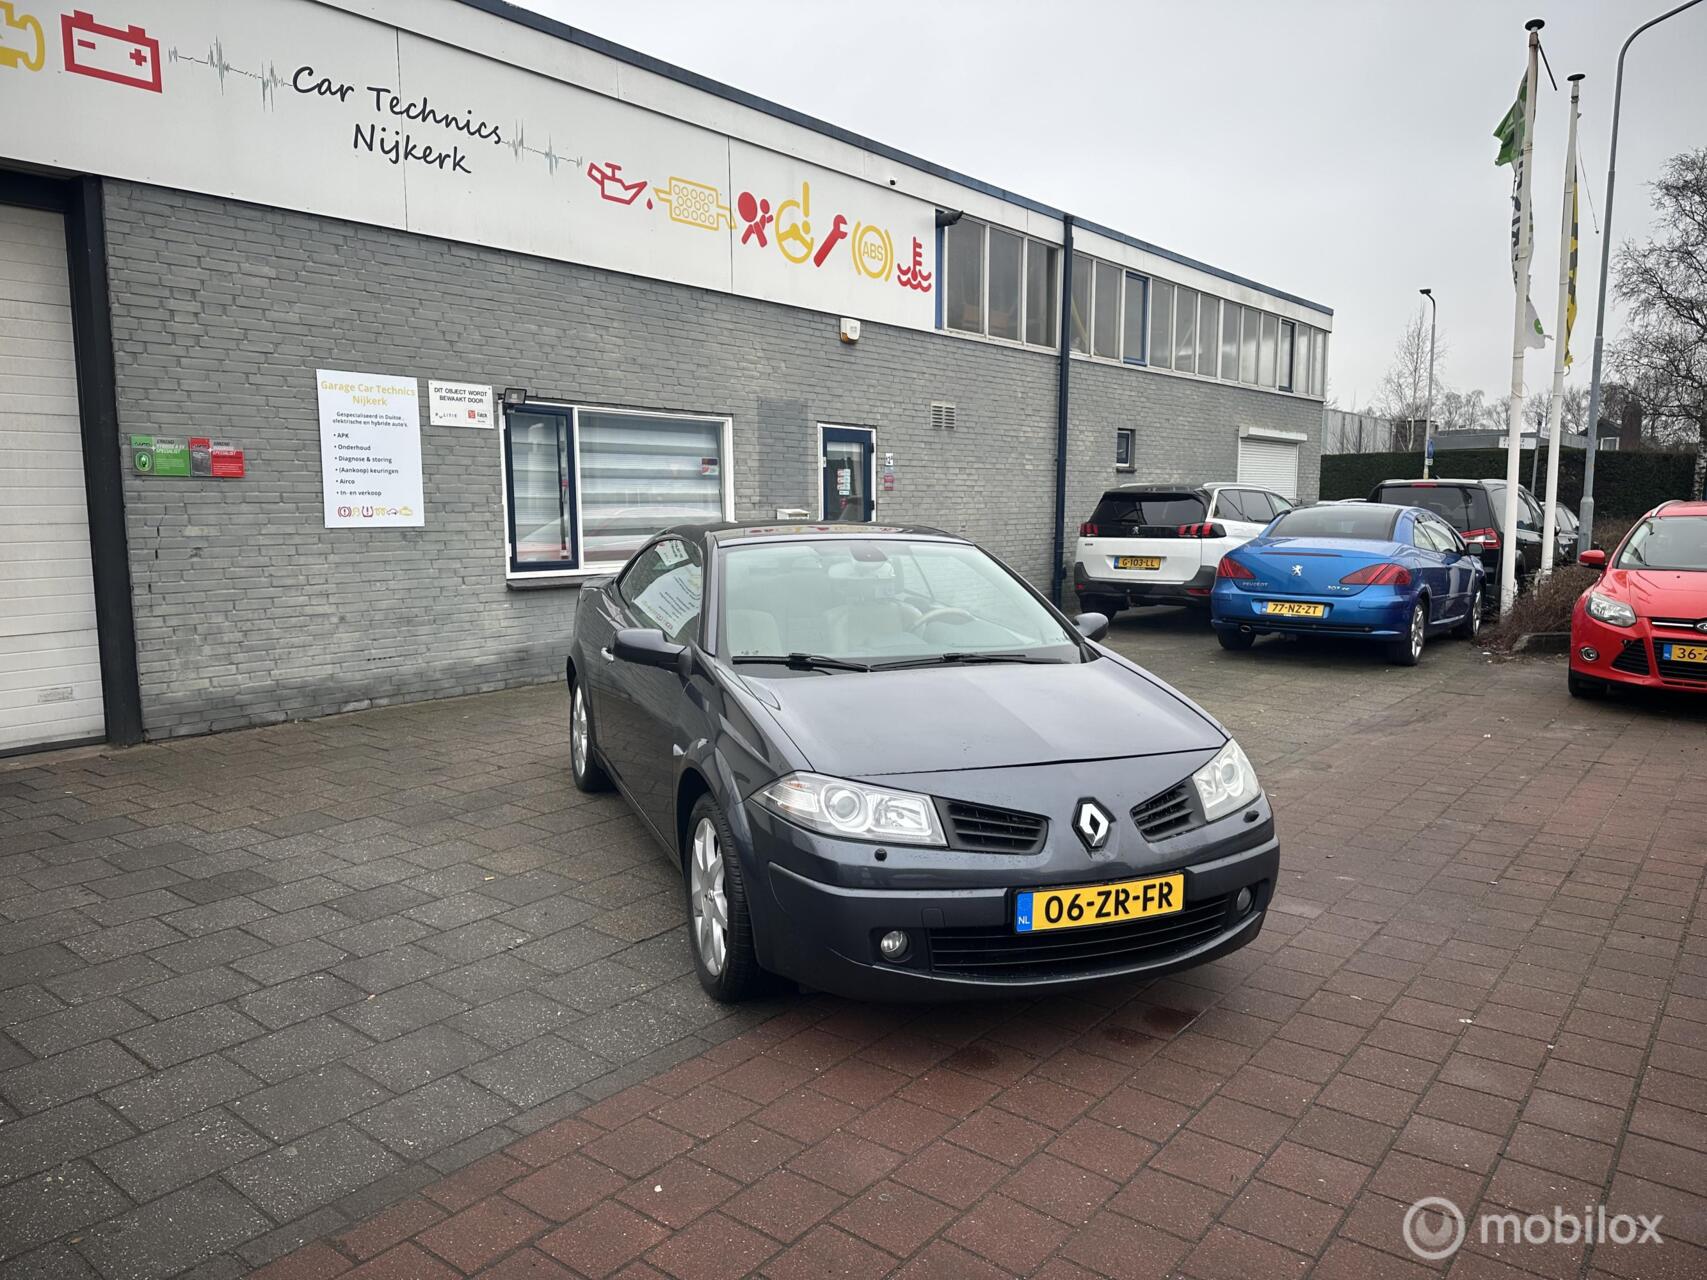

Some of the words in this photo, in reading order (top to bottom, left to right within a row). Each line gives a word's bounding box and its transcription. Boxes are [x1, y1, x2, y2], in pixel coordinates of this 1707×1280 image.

[291, 66, 354, 102] Car
[367, 85, 502, 145] Technics
[353, 123, 472, 174] Nijkerk
[862, 241, 884, 261] ABS
[321, 380, 356, 394] Garage
[358, 383, 374, 393] Car
[376, 384, 416, 396] Technics
[352, 395, 387, 406] Nijkerk
[1122, 557, 1155, 567] G-103-LL
[1272, 603, 1319, 615] 77-NZ-ZT
[1045, 882, 1173, 924] 06-ZR-FR
[1018, 916, 1030, 925] NL
